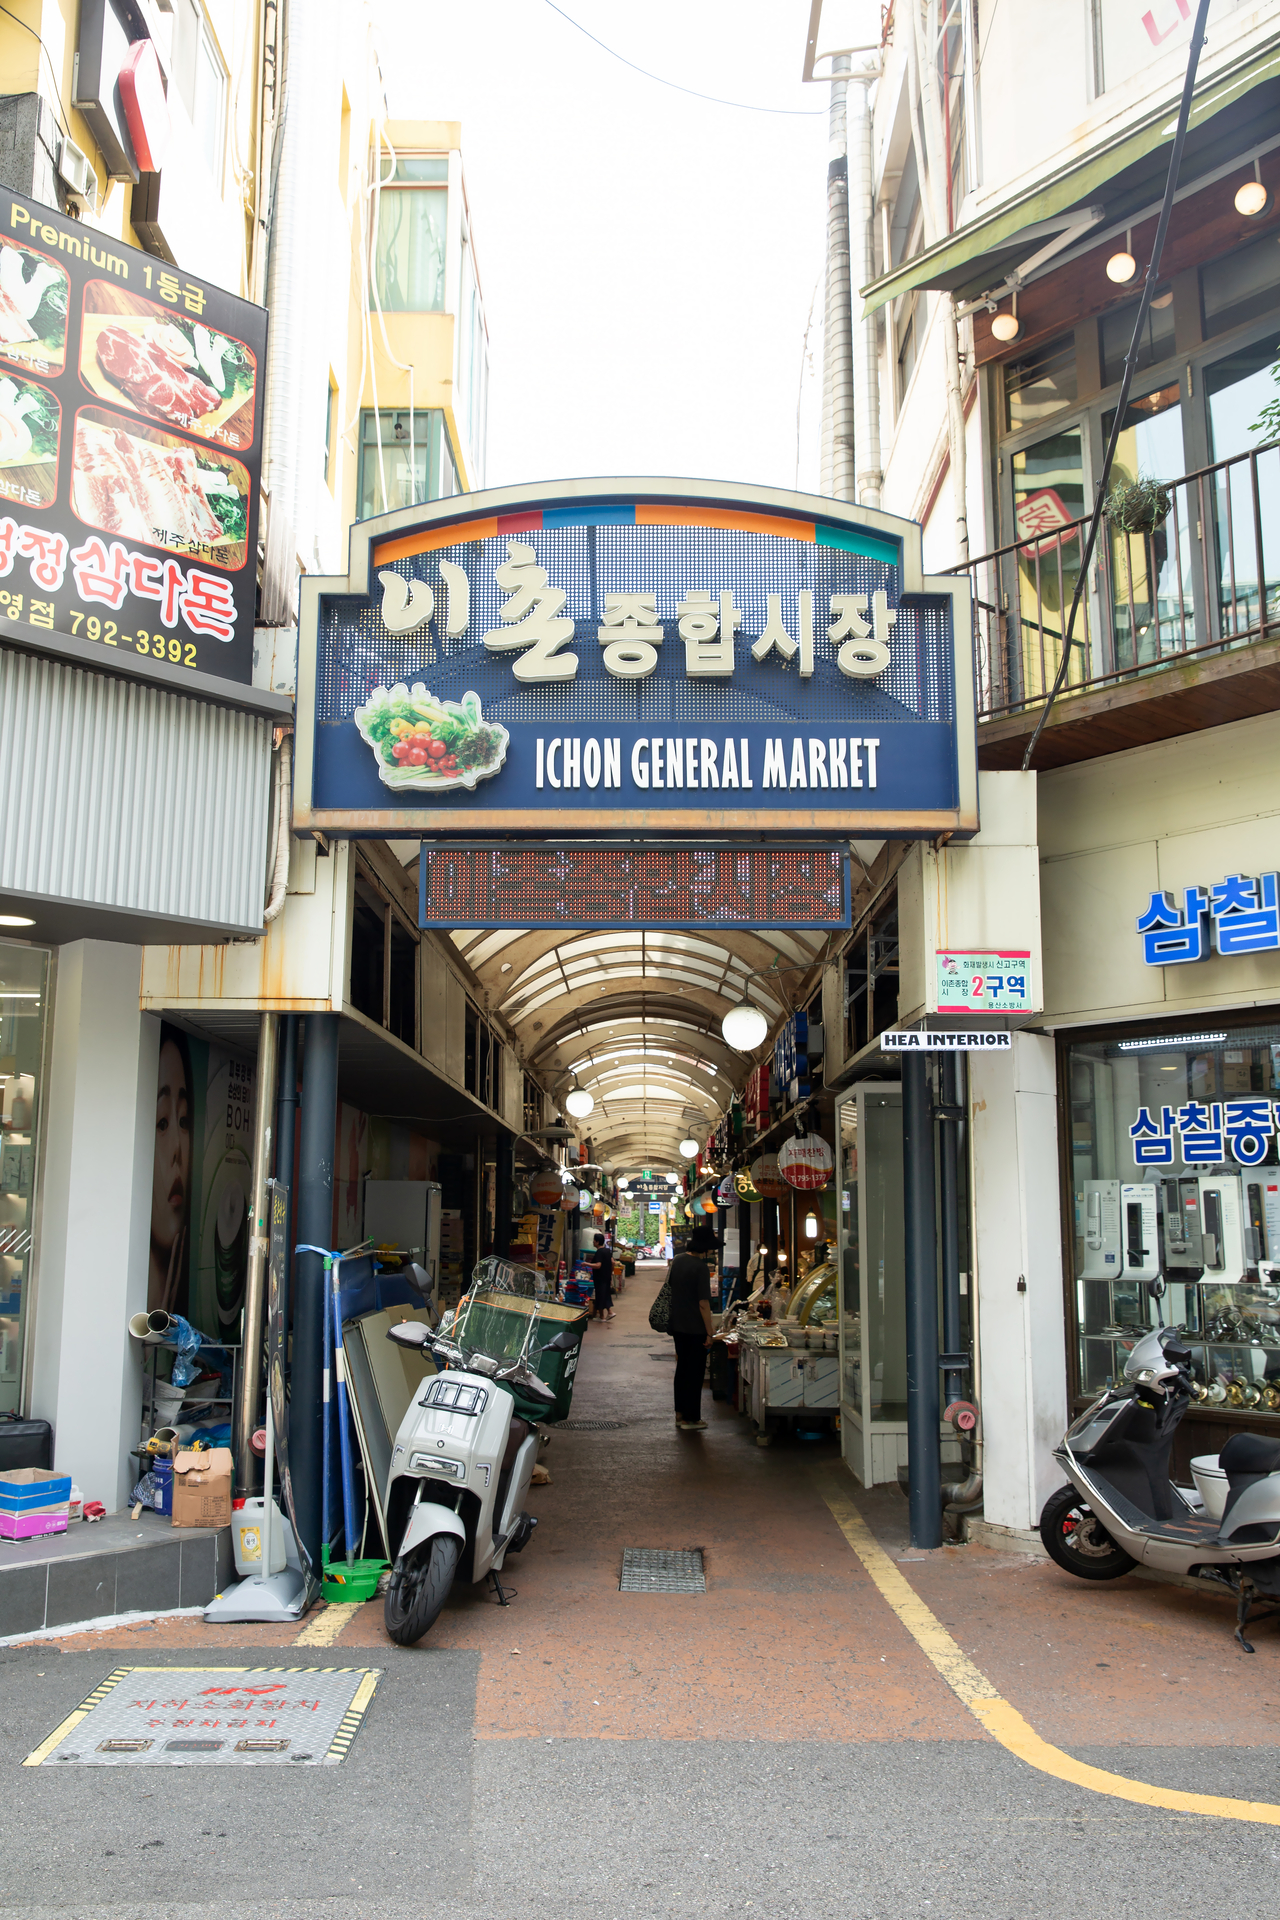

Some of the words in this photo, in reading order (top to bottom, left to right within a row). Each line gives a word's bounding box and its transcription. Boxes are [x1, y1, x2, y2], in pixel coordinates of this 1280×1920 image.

[10, 203, 129, 279] Premium
[143, 265, 207, 315] 1등급
[204, 423, 241, 448] 삼다돈
[152, 526, 186, 551] 제주
[187, 539, 230, 565] 삼다돈
[73, 537, 236, 640] 삼다돈
[69, 610, 198, 668] 792-3392
[535, 738, 622, 790] ICHON
[631, 738, 755, 790] GENERAL
[762, 738, 881, 790] MARKET
[1135, 871, 1280, 966] 삼칠
[963, 960, 995, 969] 화재발생시
[996, 960, 1026, 969] 신고구역
[971, 975, 1026, 998] 2구역
[988, 1001, 1022, 1009] 용산소방서
[884, 1034, 920, 1046] HEA
[927, 1034, 1010, 1046] INTERIOR
[226, 1103, 250, 1133] BOH
[126, 1699, 321, 1711] 지하소화장치
